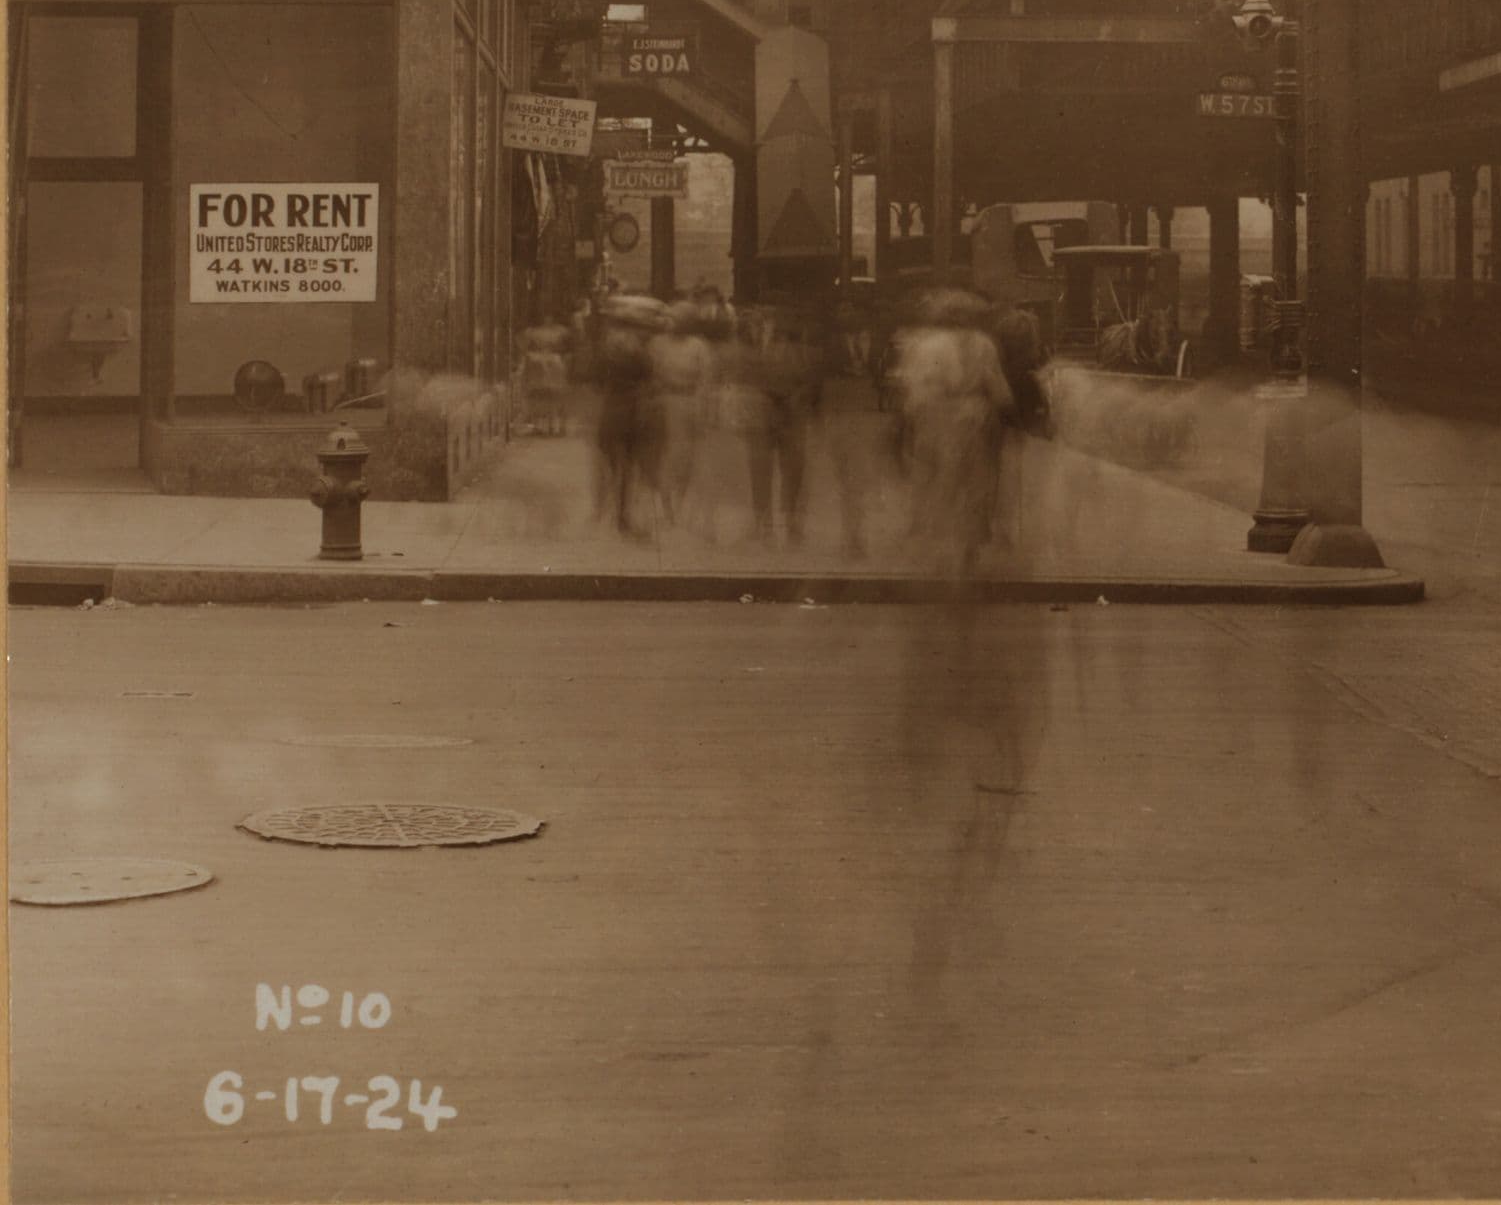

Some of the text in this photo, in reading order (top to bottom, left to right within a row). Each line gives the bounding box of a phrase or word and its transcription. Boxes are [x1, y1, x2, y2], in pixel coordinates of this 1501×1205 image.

[629, 53, 689, 73] SODA
[508, 102, 589, 121] BASEMENT SPACE
[1222, 95, 1249, 115] 57
[1254, 96, 1276, 115] ST
[518, 115, 580, 128] TO LET
[198, 193, 372, 228] FOR RENT
[196, 233, 244, 253] UNITED
[246, 233, 294, 253] STORES
[296, 233, 341, 253] REALTY
[206, 258, 243, 274] 44
[252, 258, 278, 274] W.
[322, 258, 359, 274] ST.
[216, 279, 290, 293] WATKINS
